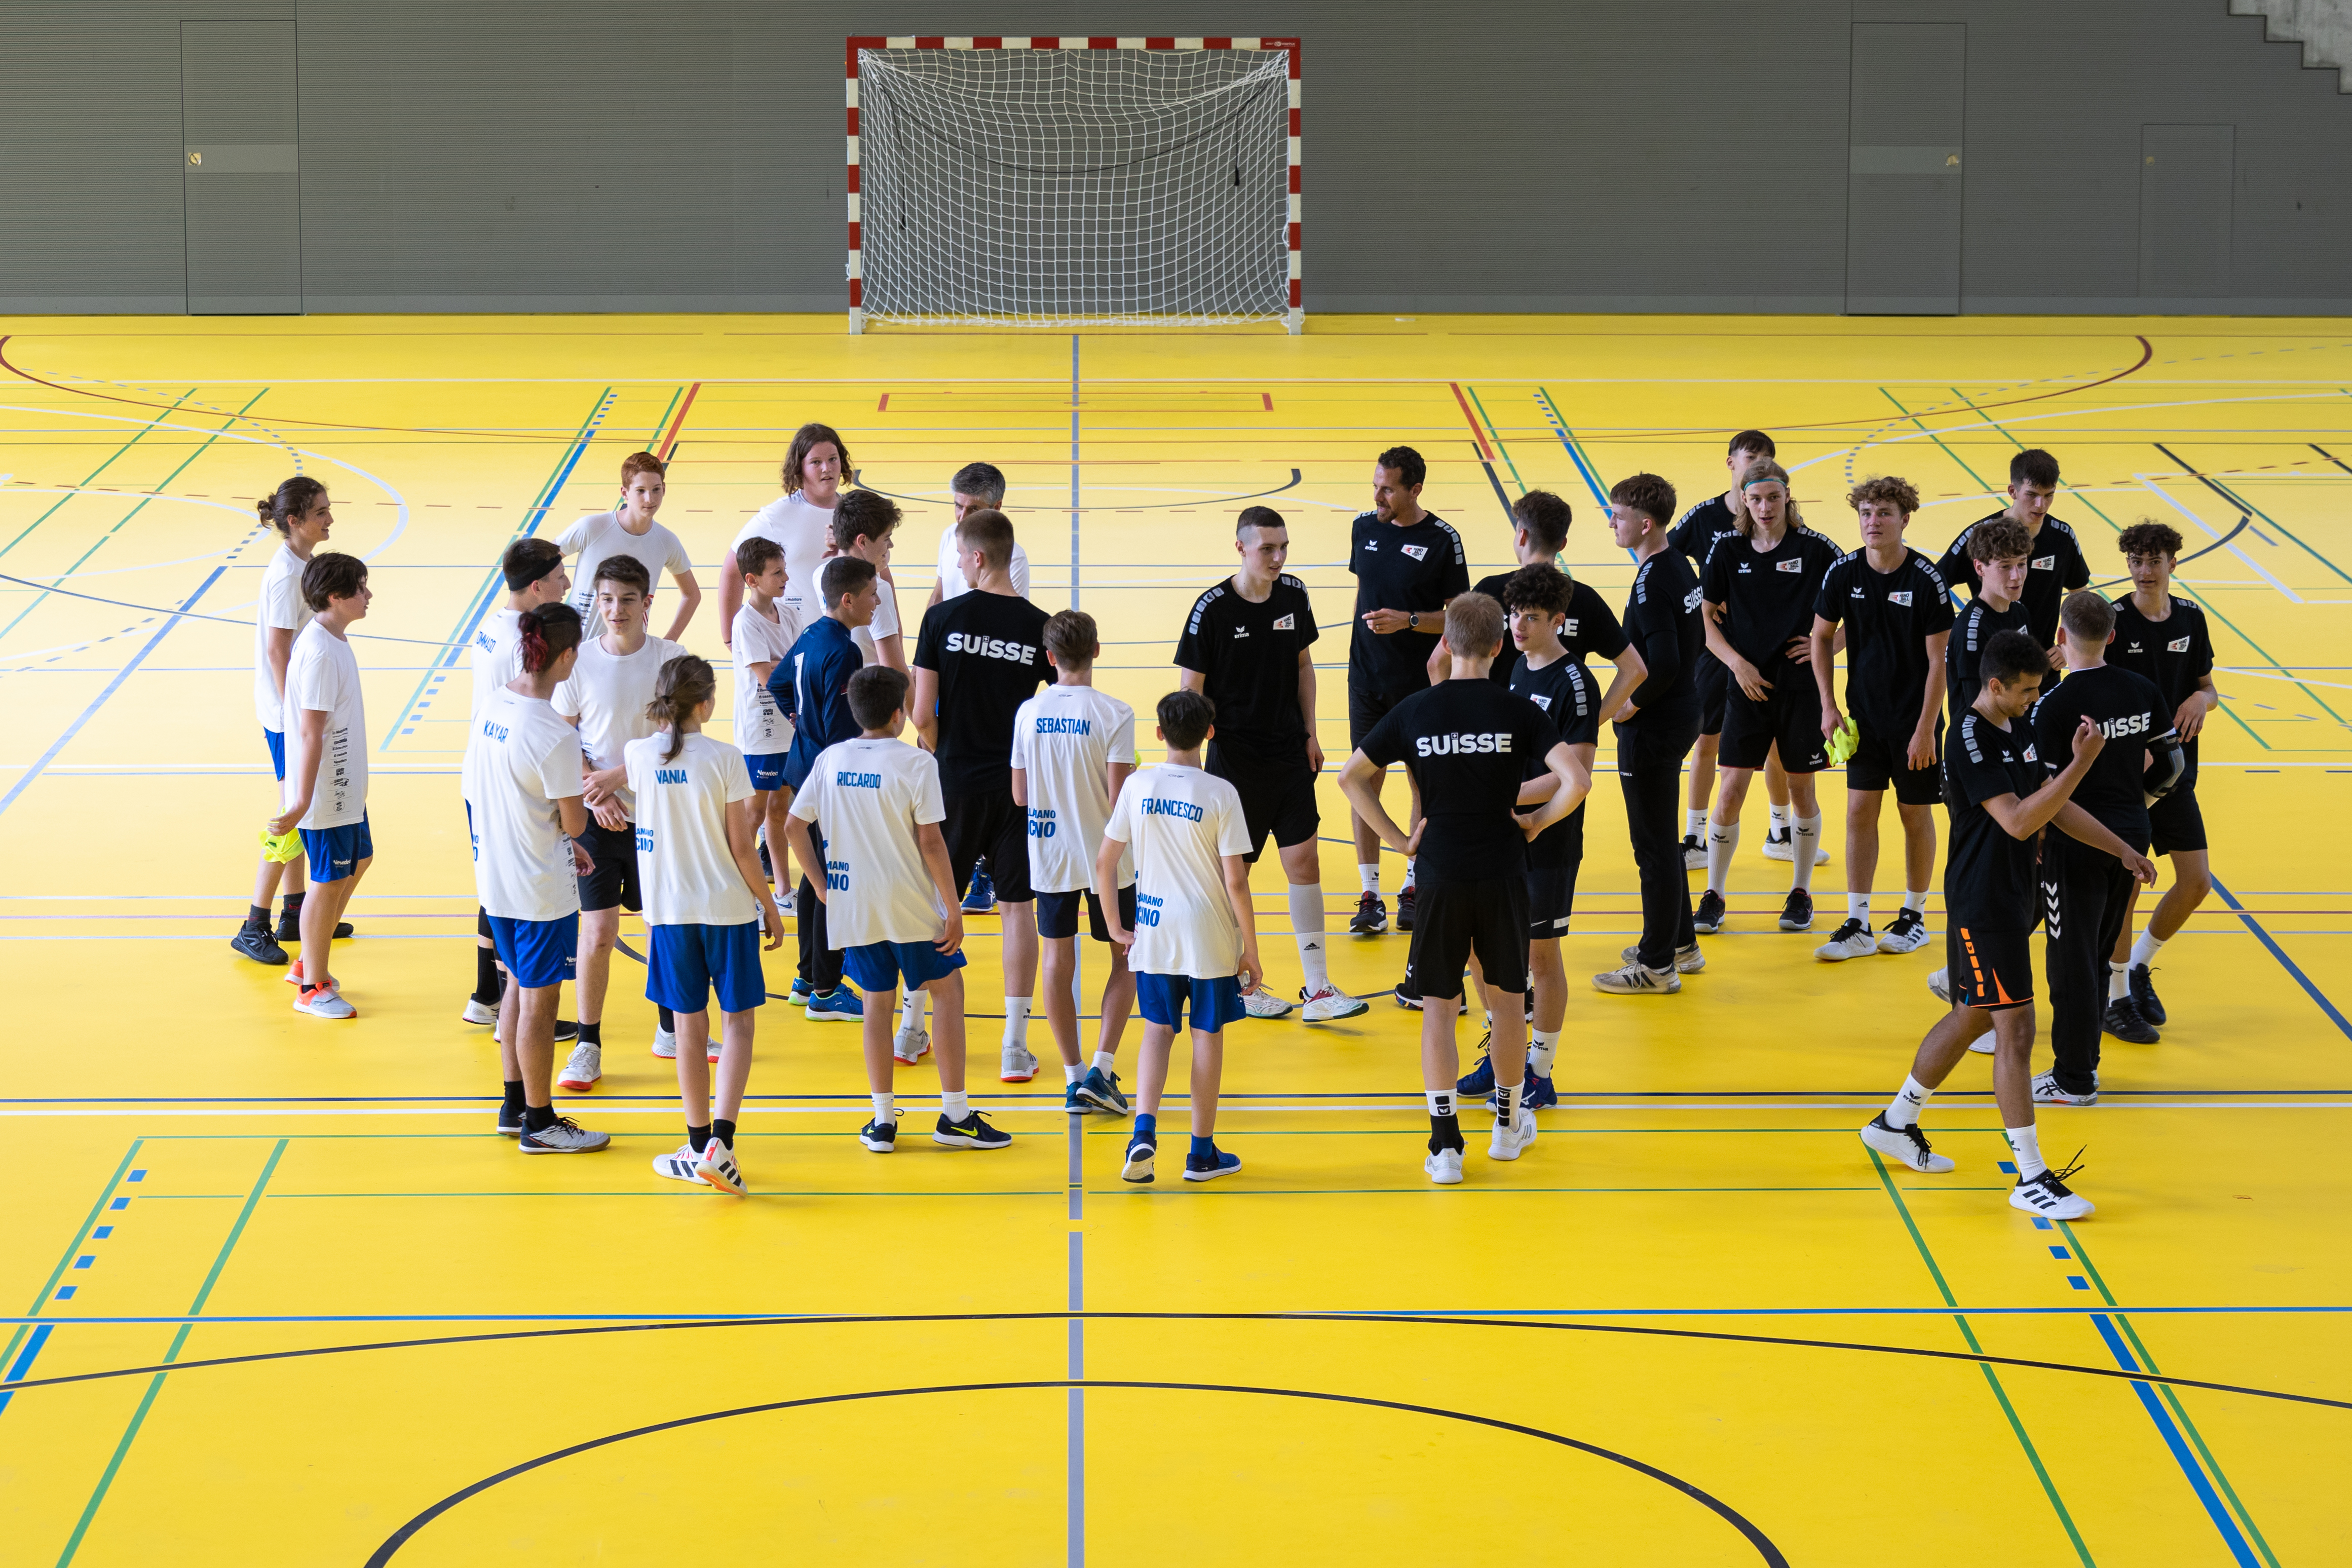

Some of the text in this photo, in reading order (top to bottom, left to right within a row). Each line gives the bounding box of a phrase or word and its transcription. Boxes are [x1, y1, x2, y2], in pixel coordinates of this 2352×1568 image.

[794, 652, 805, 715] 1
[483, 720, 508, 744] KAYAR
[1037, 718, 1090, 736] SEBASTIAN
[655, 770, 688, 784] VANIA
[837, 772, 881, 789] RICCARDO
[1142, 798, 1203, 823] FRANCESCO
[1903, 1095, 1920, 1105] erima
